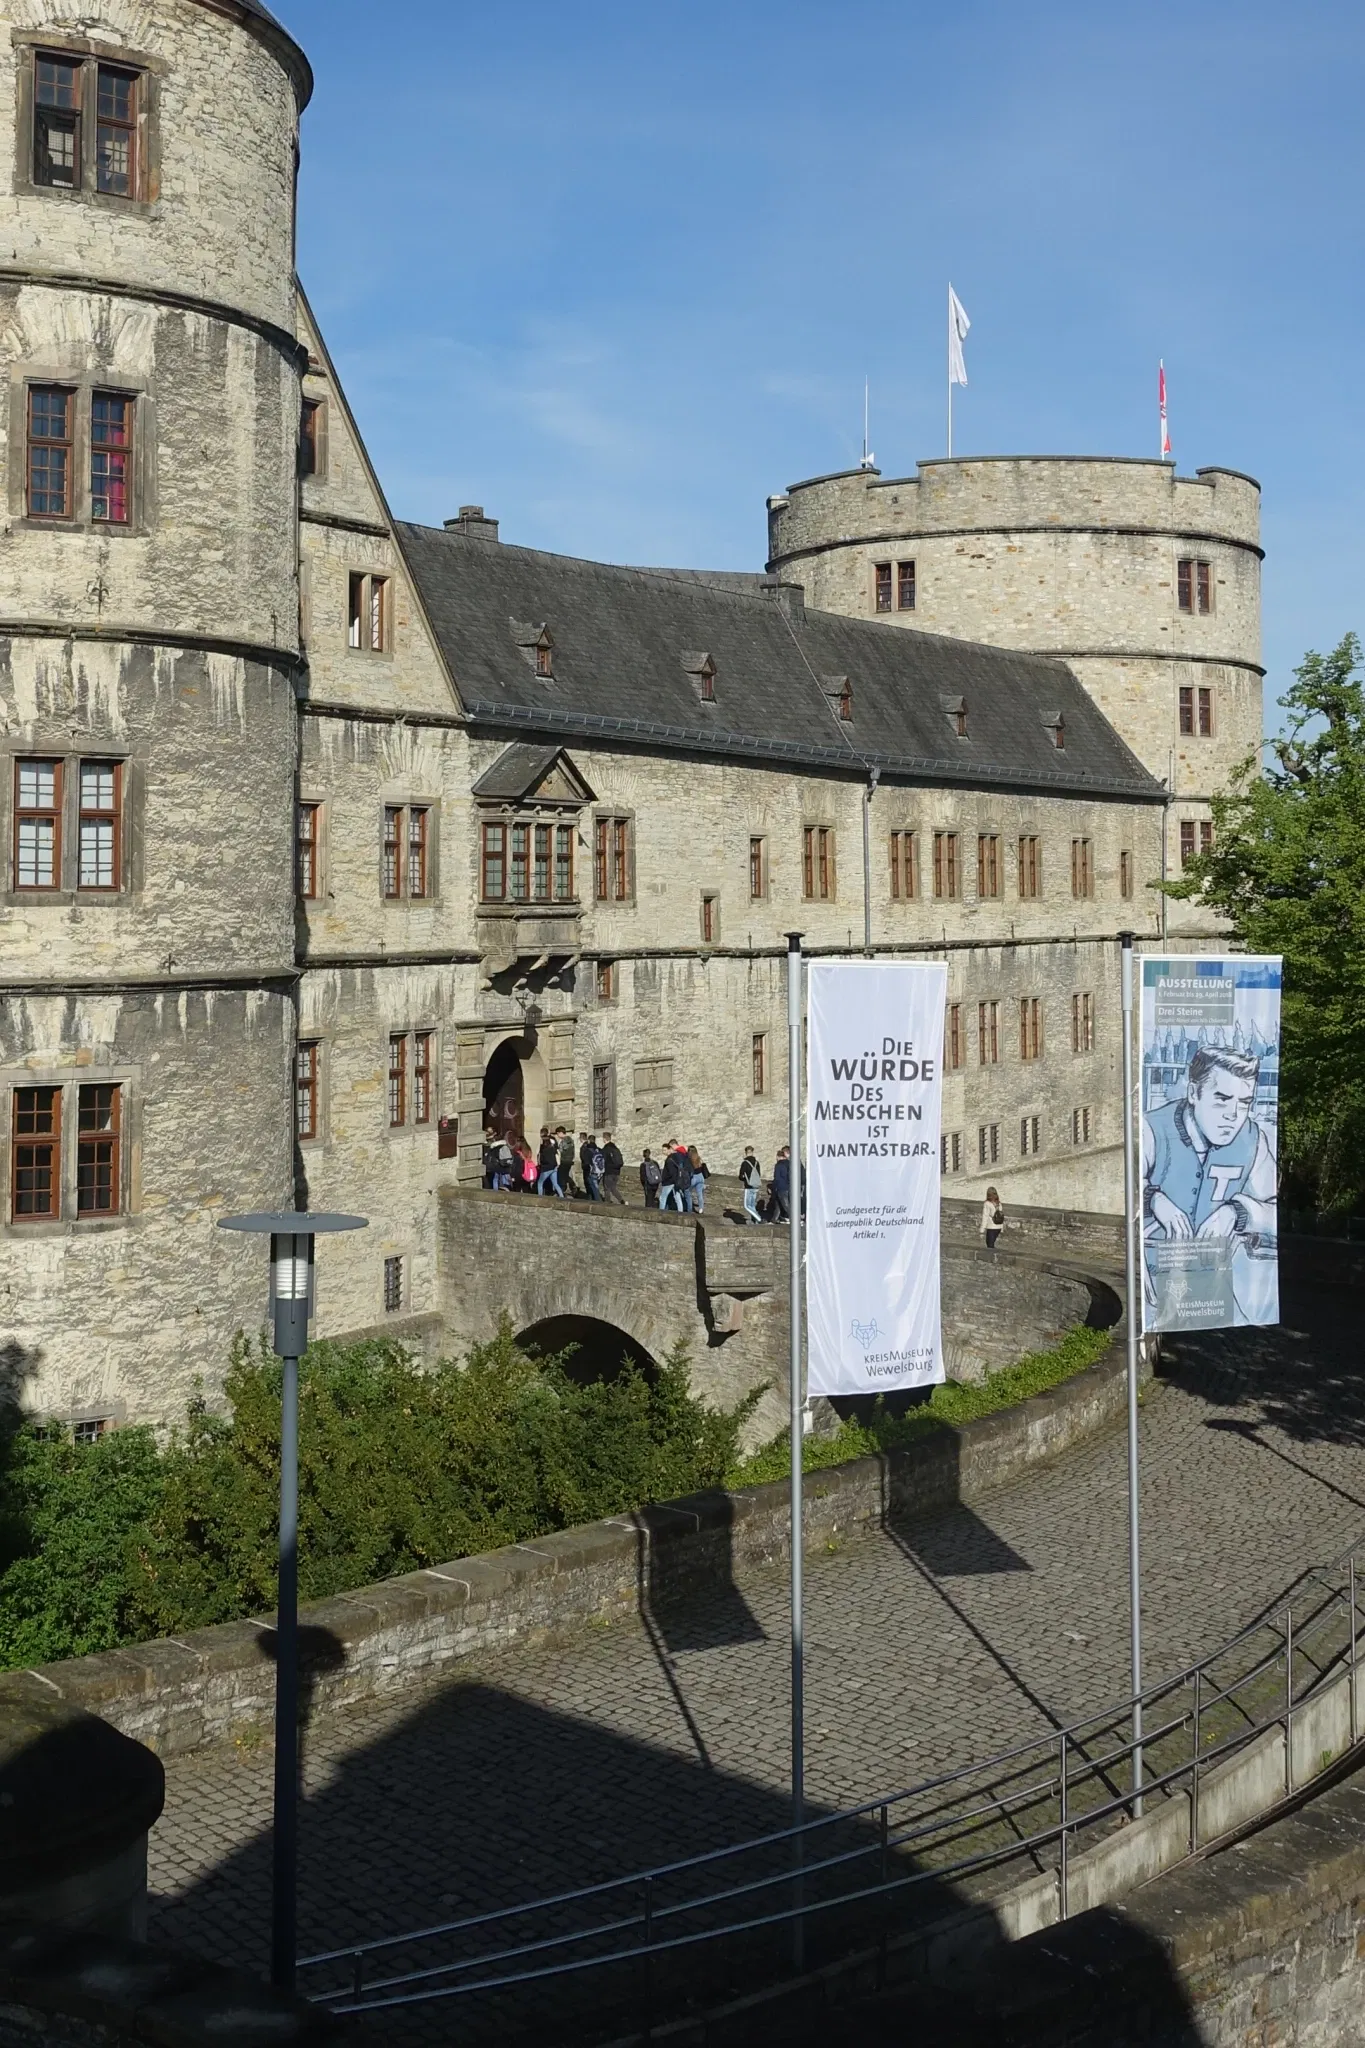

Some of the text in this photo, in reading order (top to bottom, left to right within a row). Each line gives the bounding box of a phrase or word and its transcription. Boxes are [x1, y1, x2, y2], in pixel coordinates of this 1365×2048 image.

[1158, 978, 1233, 989] AUSSTELLUNG
[1163, 990, 1185, 998] Februar
[1186, 990, 1194, 998] bis
[1205, 991, 1219, 999] April
[1158, 1007, 1203, 1016] Drei Steine
[831, 1052, 934, 1081] WÜRDE
[814, 1100, 922, 1120] MENSCHEN
[867, 1125, 890, 1138] IST
[816, 1142, 936, 1158] UNANTASTBAR.
[1207, 1164, 1245, 1201] T
[835, 1205, 908, 1217] Grundgesetz für die
[826, 1217, 873, 1230] undesrepublik
[853, 1230, 879, 1240] Artikel
[1177, 1307, 1225, 1317] Wewelsburg
[866, 1360, 933, 1377] Wewelsburg
